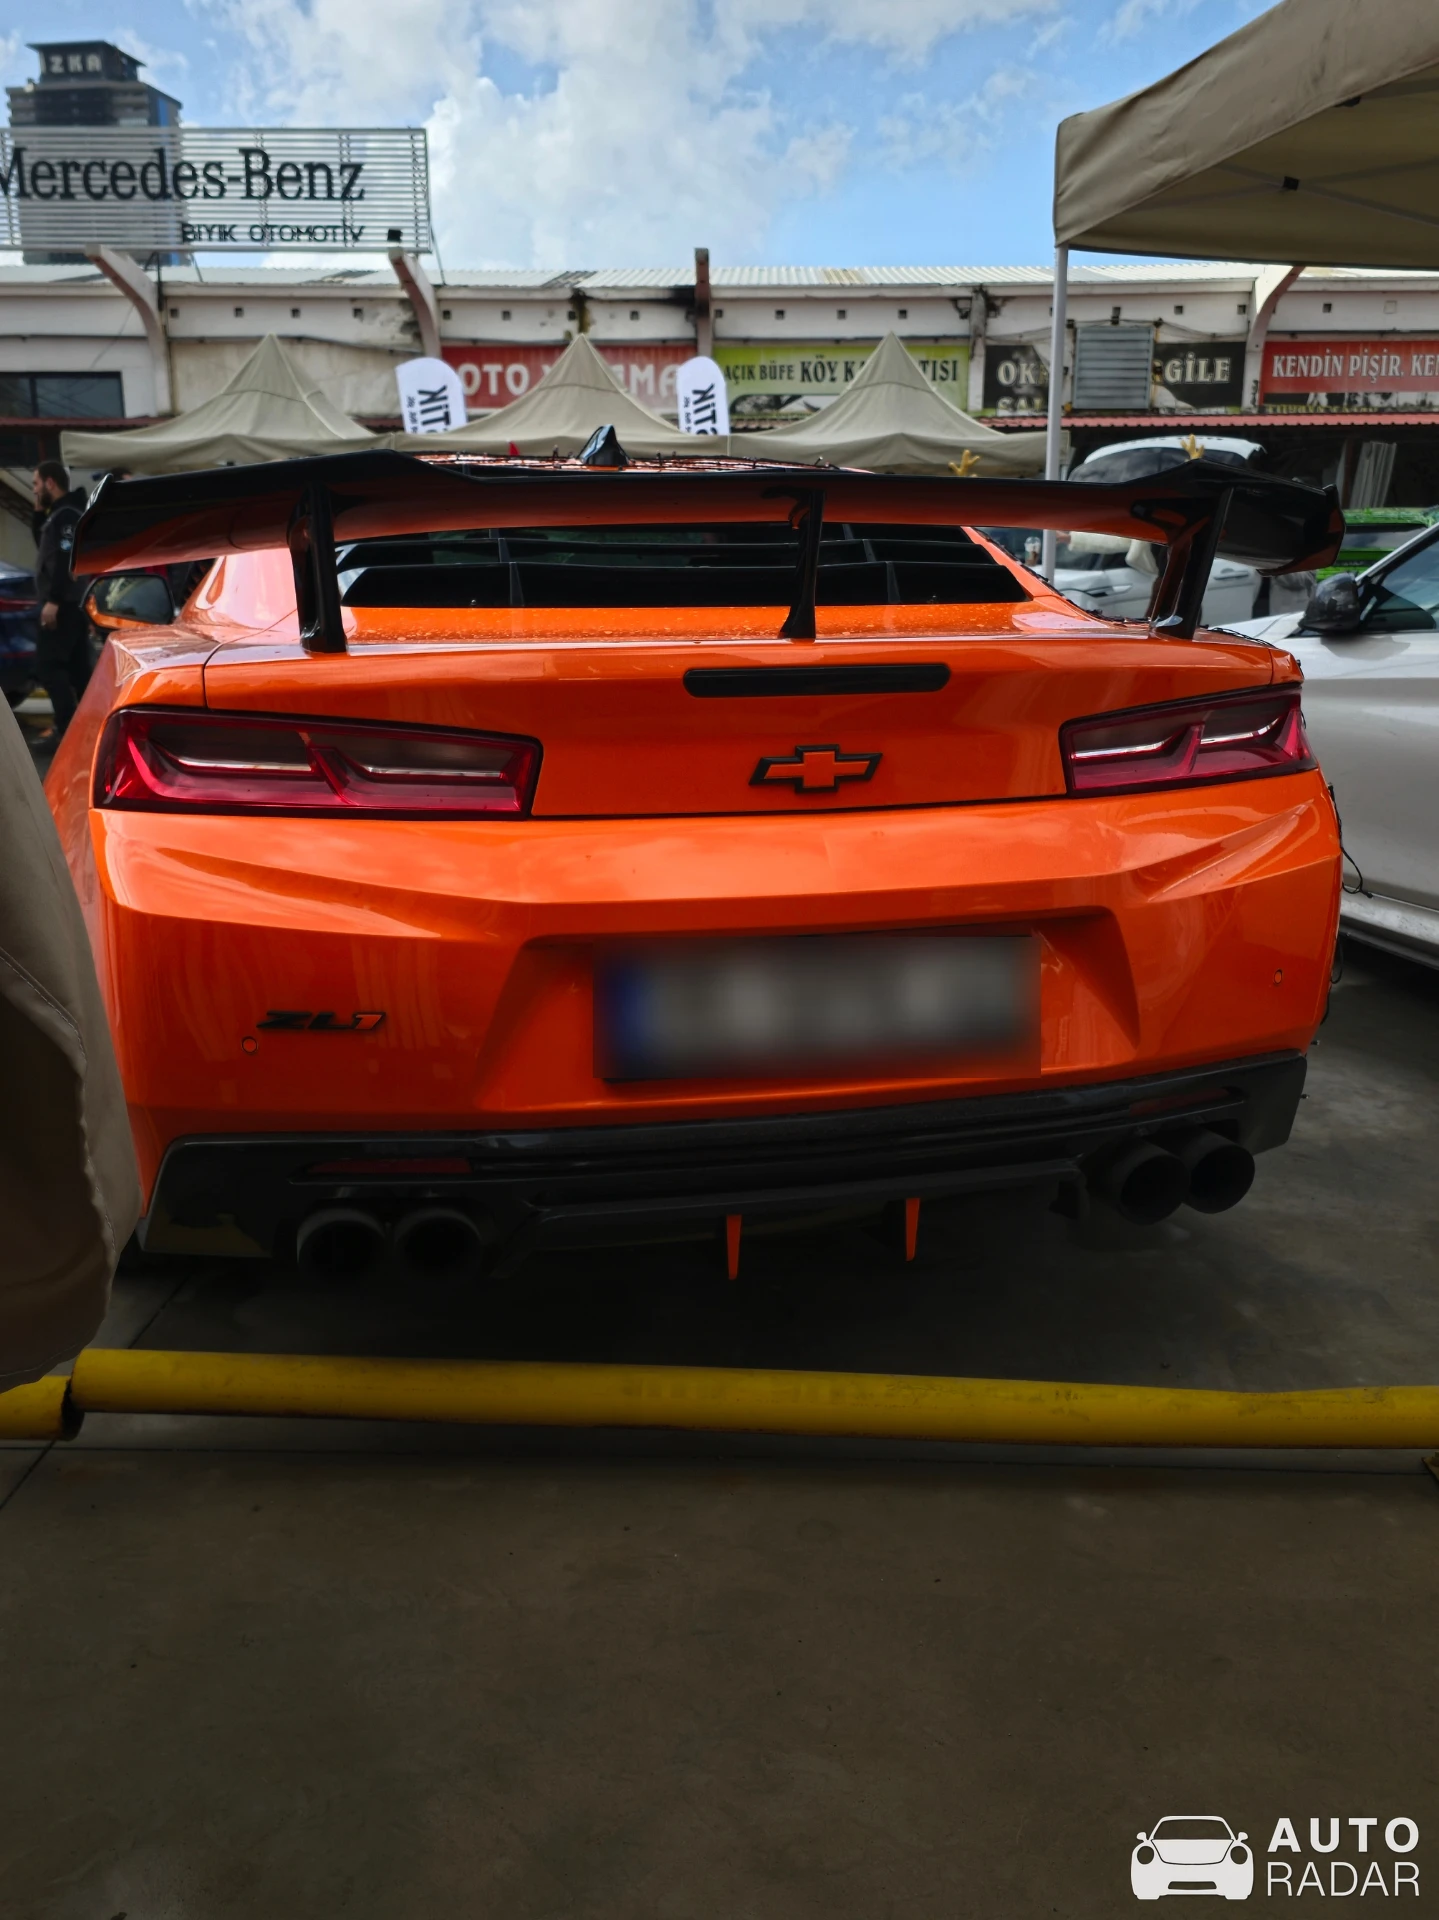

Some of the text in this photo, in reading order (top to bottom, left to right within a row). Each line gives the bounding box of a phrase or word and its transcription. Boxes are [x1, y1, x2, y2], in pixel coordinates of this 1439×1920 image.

[0, 147, 366, 201] Mercedes-Benz
[724, 364, 756, 386] AÇIK
[759, 360, 794, 381] BÜFE
[800, 354, 838, 383] KÖY
[1271, 348, 1344, 378] KENDİN
[459, 363, 530, 397] OTO
[256, 1010, 387, 1031] ZL1
